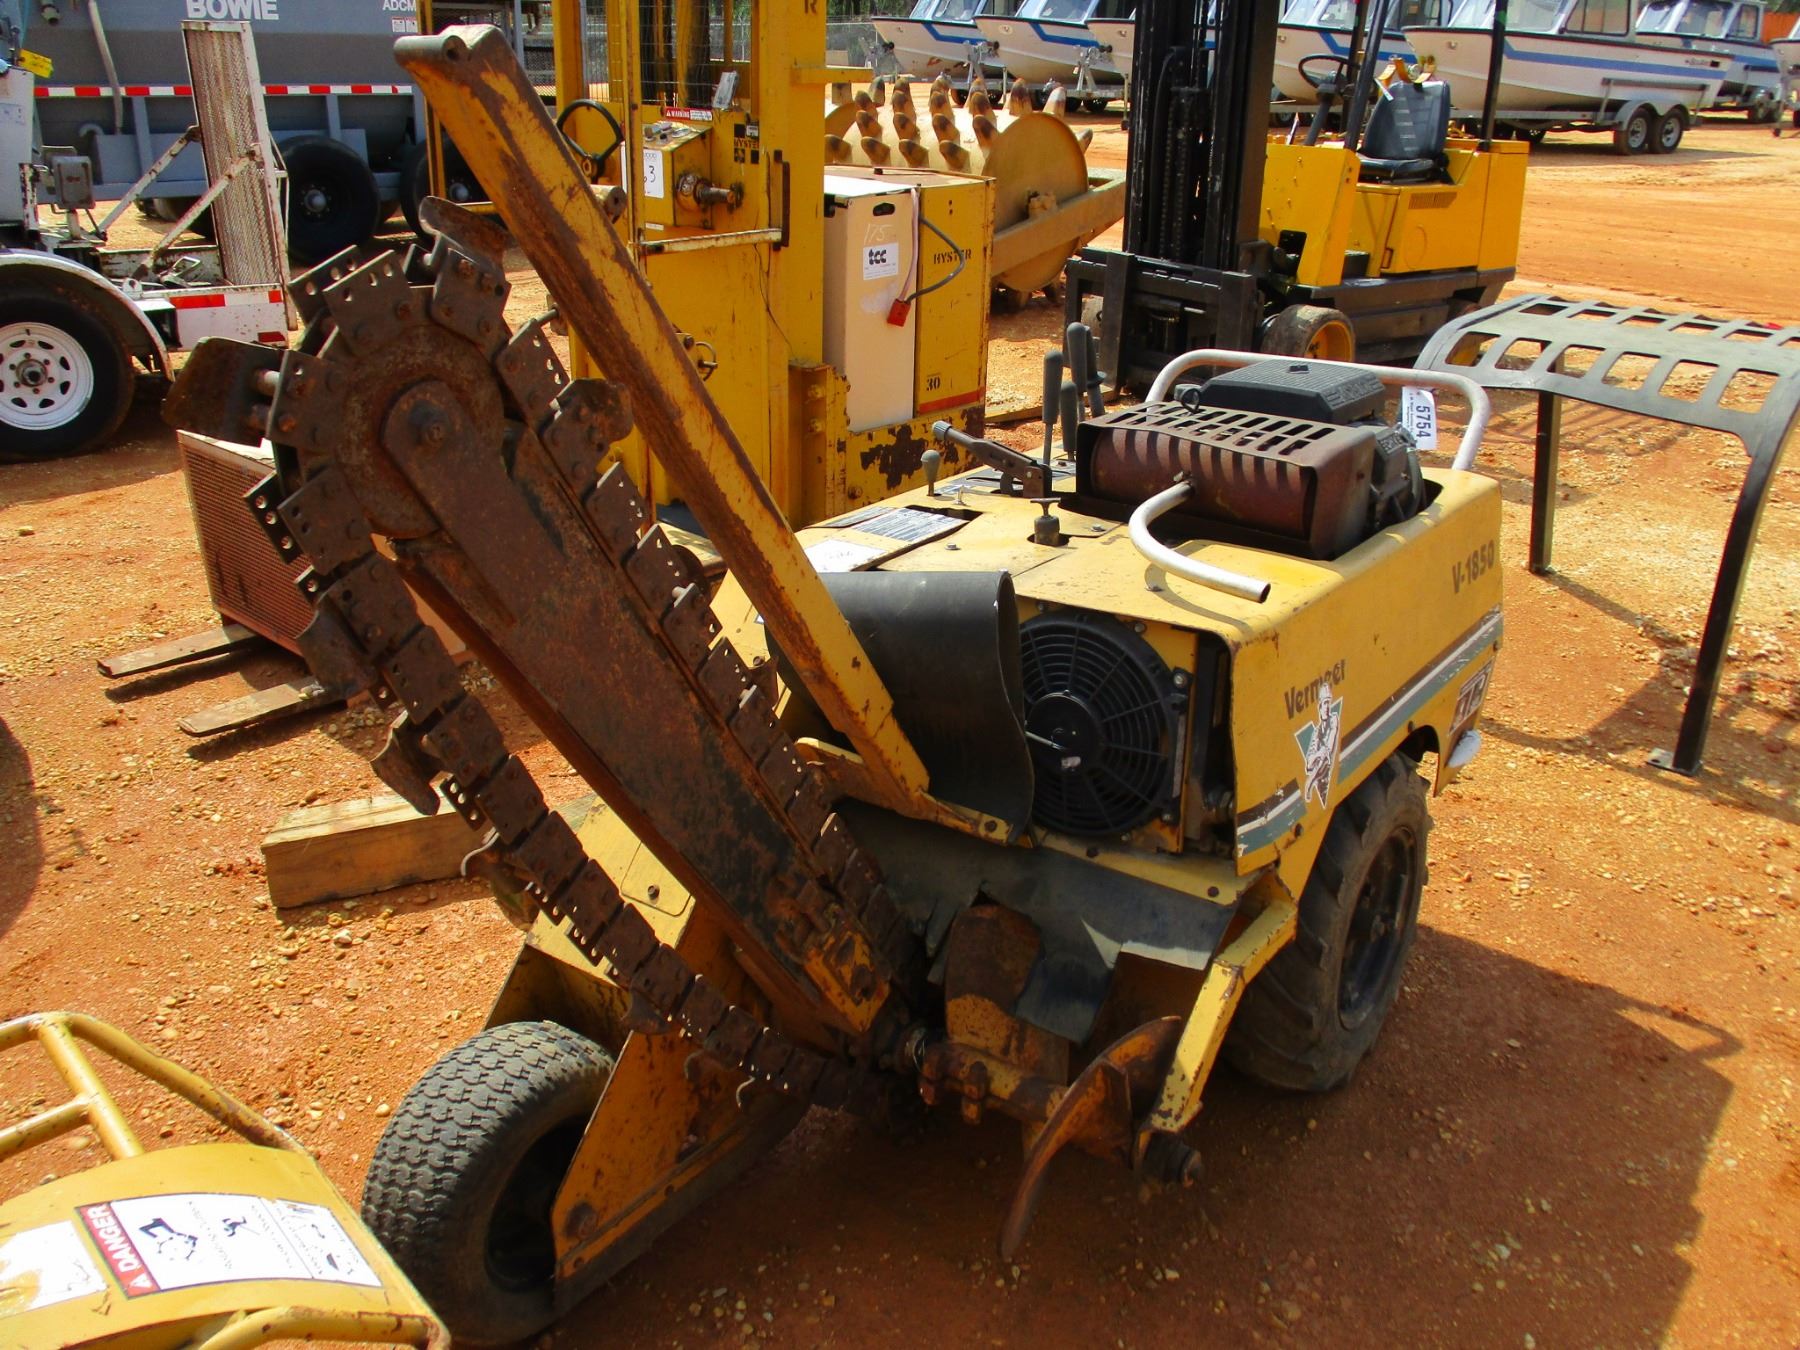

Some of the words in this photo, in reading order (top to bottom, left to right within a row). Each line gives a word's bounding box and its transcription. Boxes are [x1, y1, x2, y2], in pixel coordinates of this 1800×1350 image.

[186, 0, 279, 20] BOWIE
[869, 249, 887, 265] tcc
[933, 249, 972, 264] HYSTR
[926, 376, 941, 391] 30
[1416, 405, 1431, 437] 5754
[1452, 539, 1495, 595] V-1850
[87, 1204, 143, 1273] DANGER
